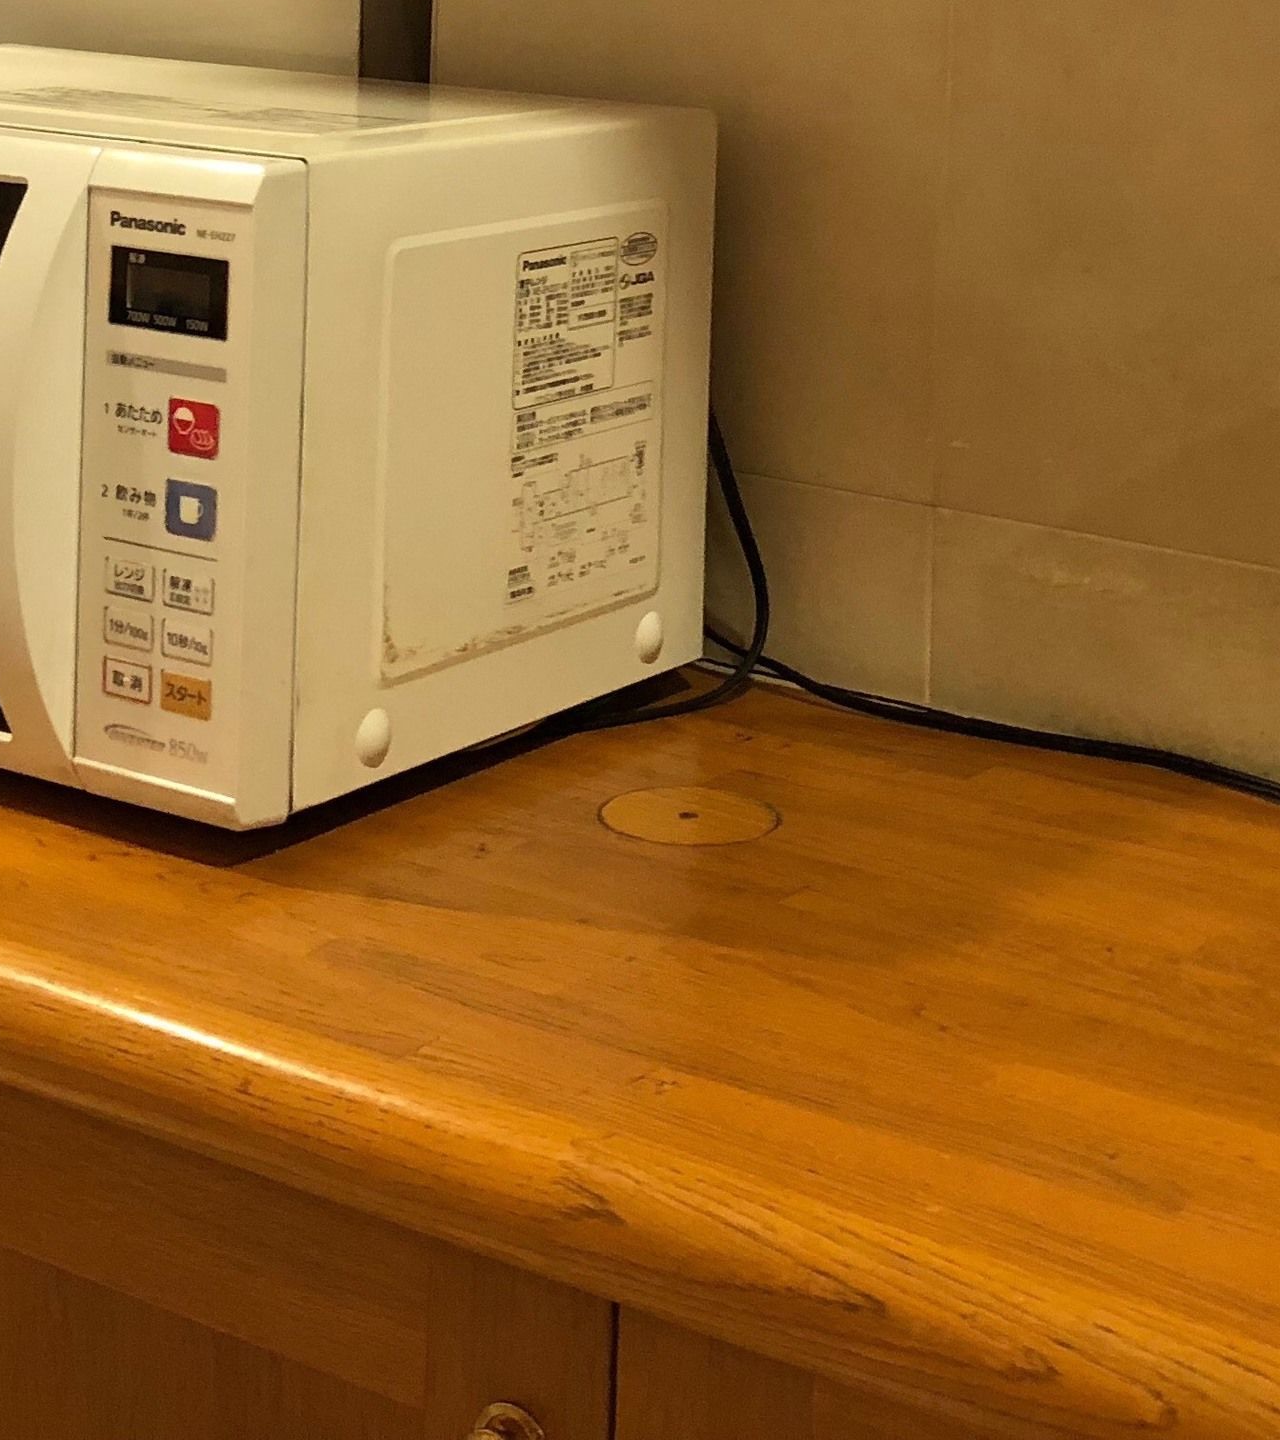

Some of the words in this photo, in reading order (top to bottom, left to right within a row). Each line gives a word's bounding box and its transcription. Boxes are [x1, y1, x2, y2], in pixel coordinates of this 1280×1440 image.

[110, 211, 186, 236] Panasonic
[523, 257, 567, 271] Panasonic
[115, 402, 163, 424] あたため
[101, 484, 109, 498] 2
[115, 484, 157, 508] 飲み物
[114, 564, 144, 581] レンジ
[165, 681, 207, 706] スタート
